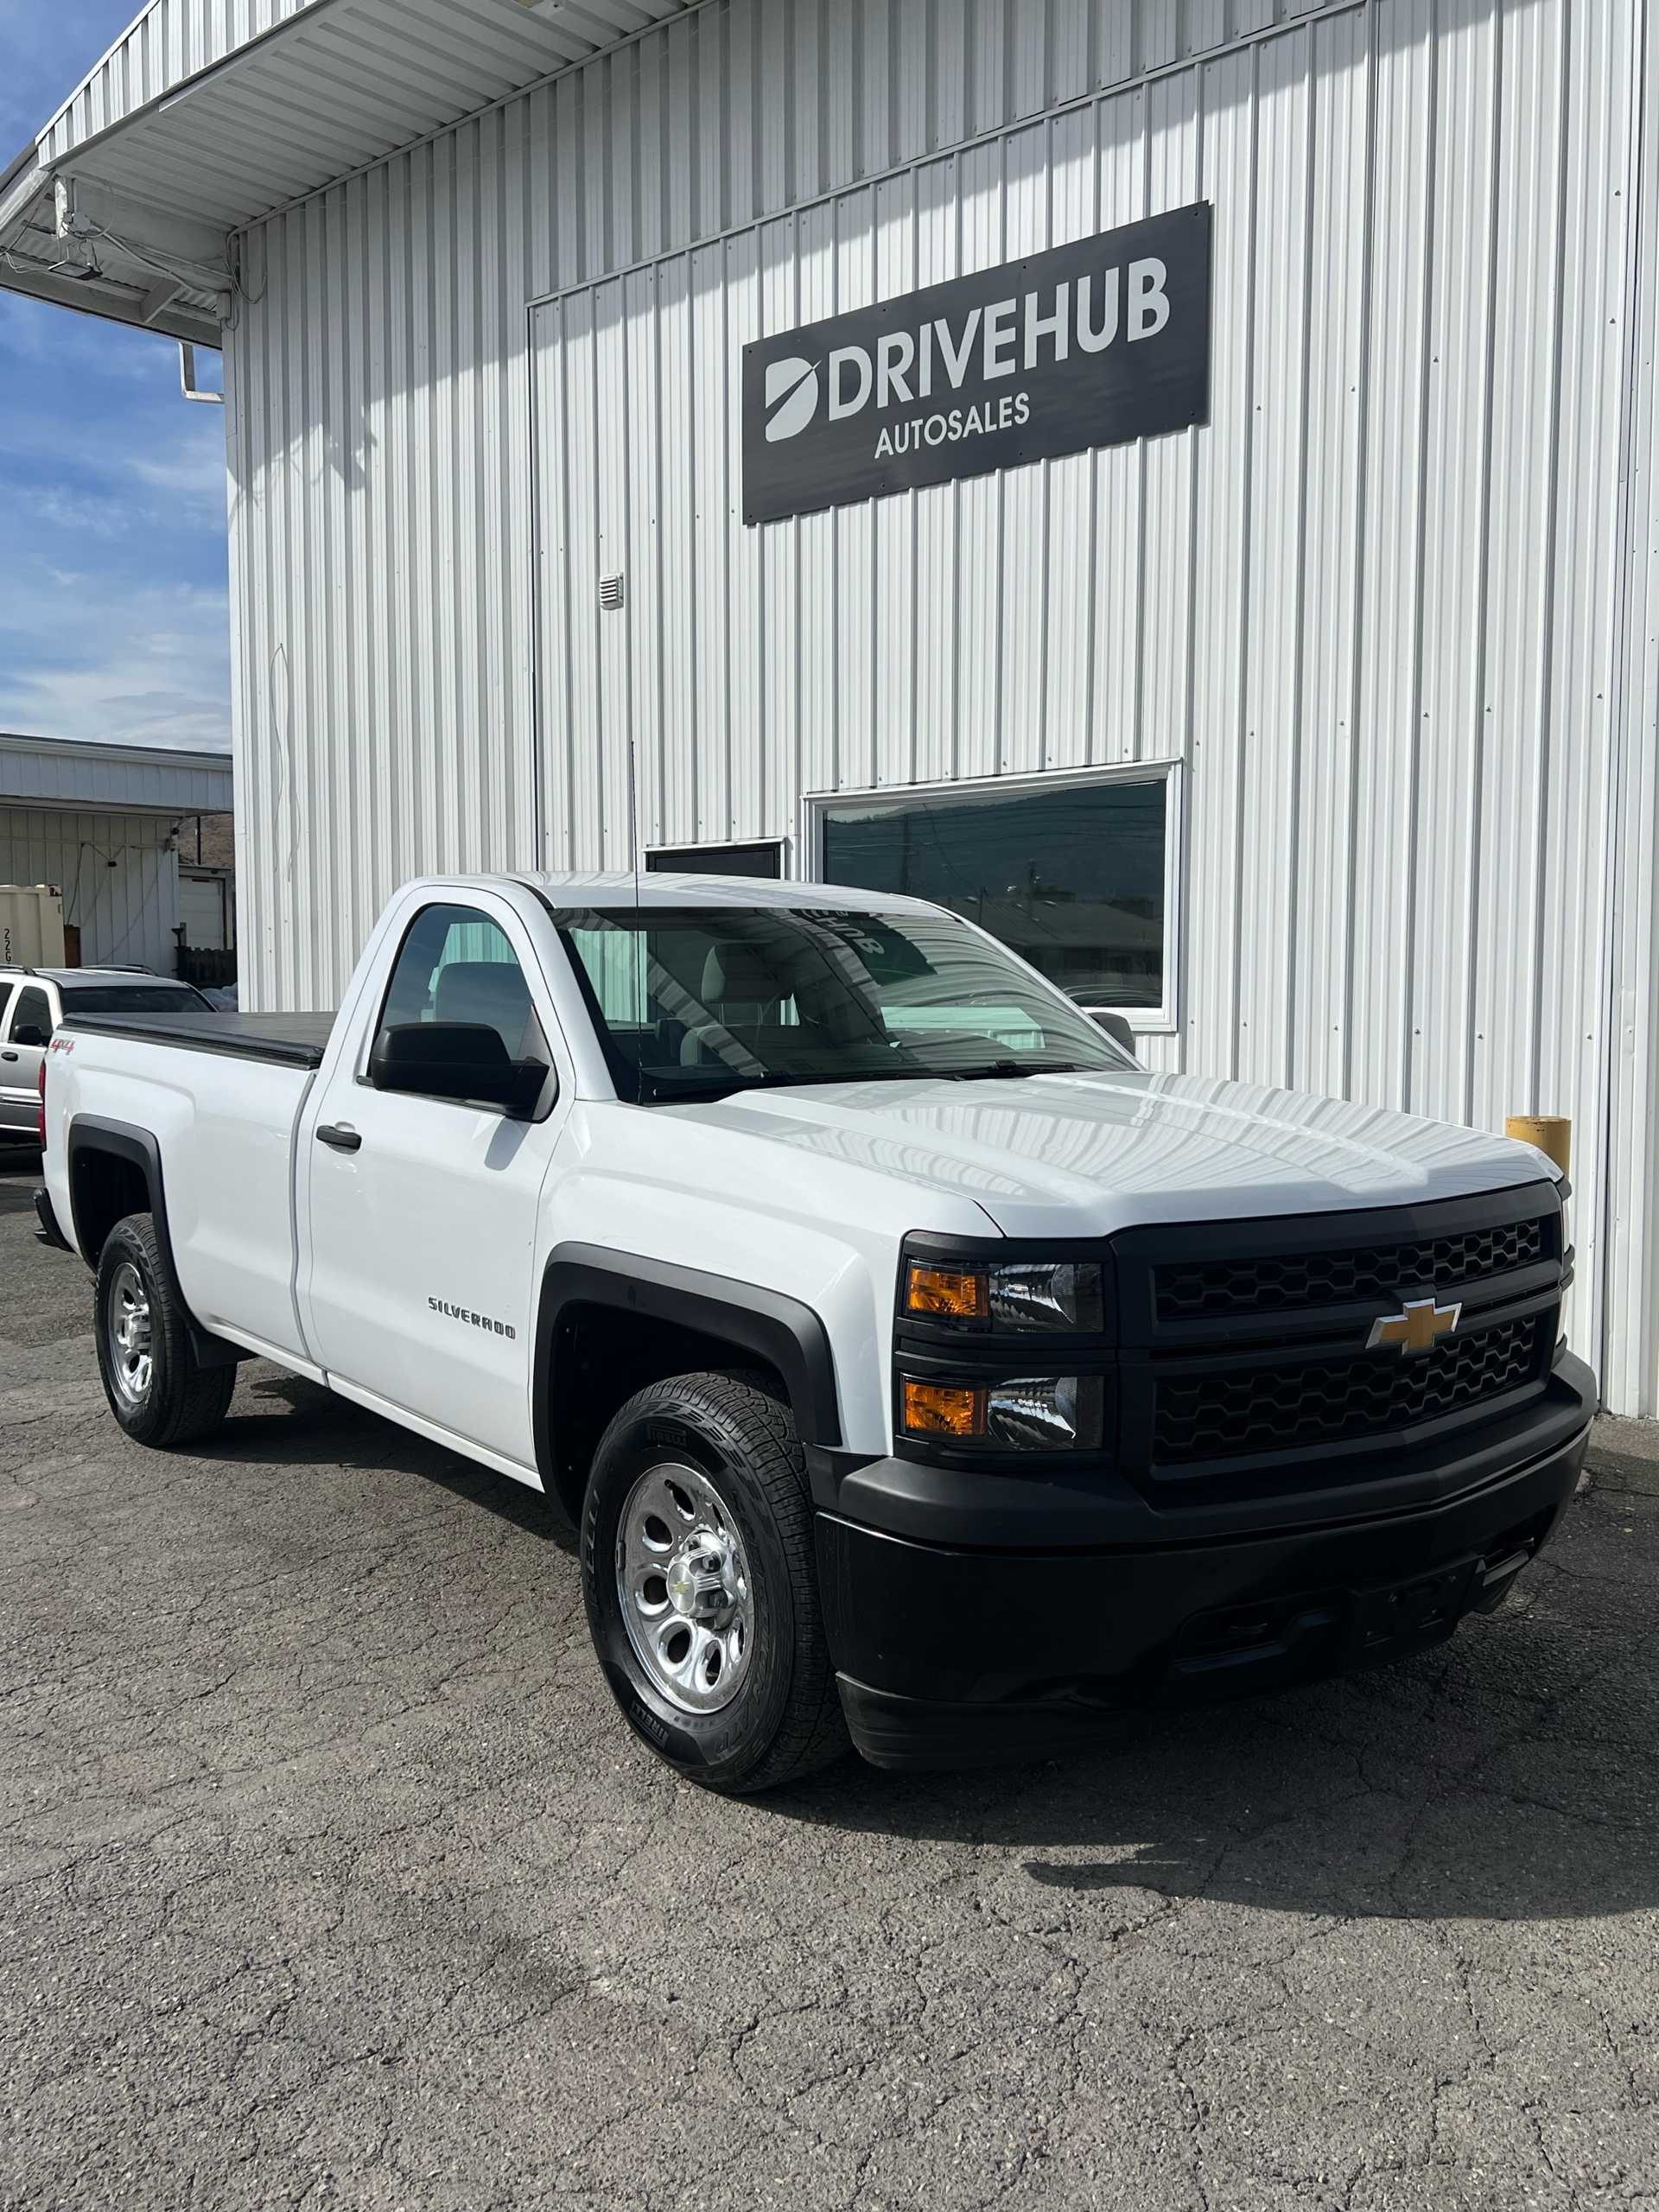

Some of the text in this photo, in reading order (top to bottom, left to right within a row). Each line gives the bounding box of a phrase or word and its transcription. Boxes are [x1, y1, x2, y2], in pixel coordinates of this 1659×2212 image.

[828, 257, 1171, 422] DRIVEHUB
[874, 392, 1030, 459] AUTOSALES
[428, 1297, 516, 1340] SILVERADO
[646, 1423, 688, 1447] PIRELLI
[631, 1699, 670, 1751] PIRELLI
